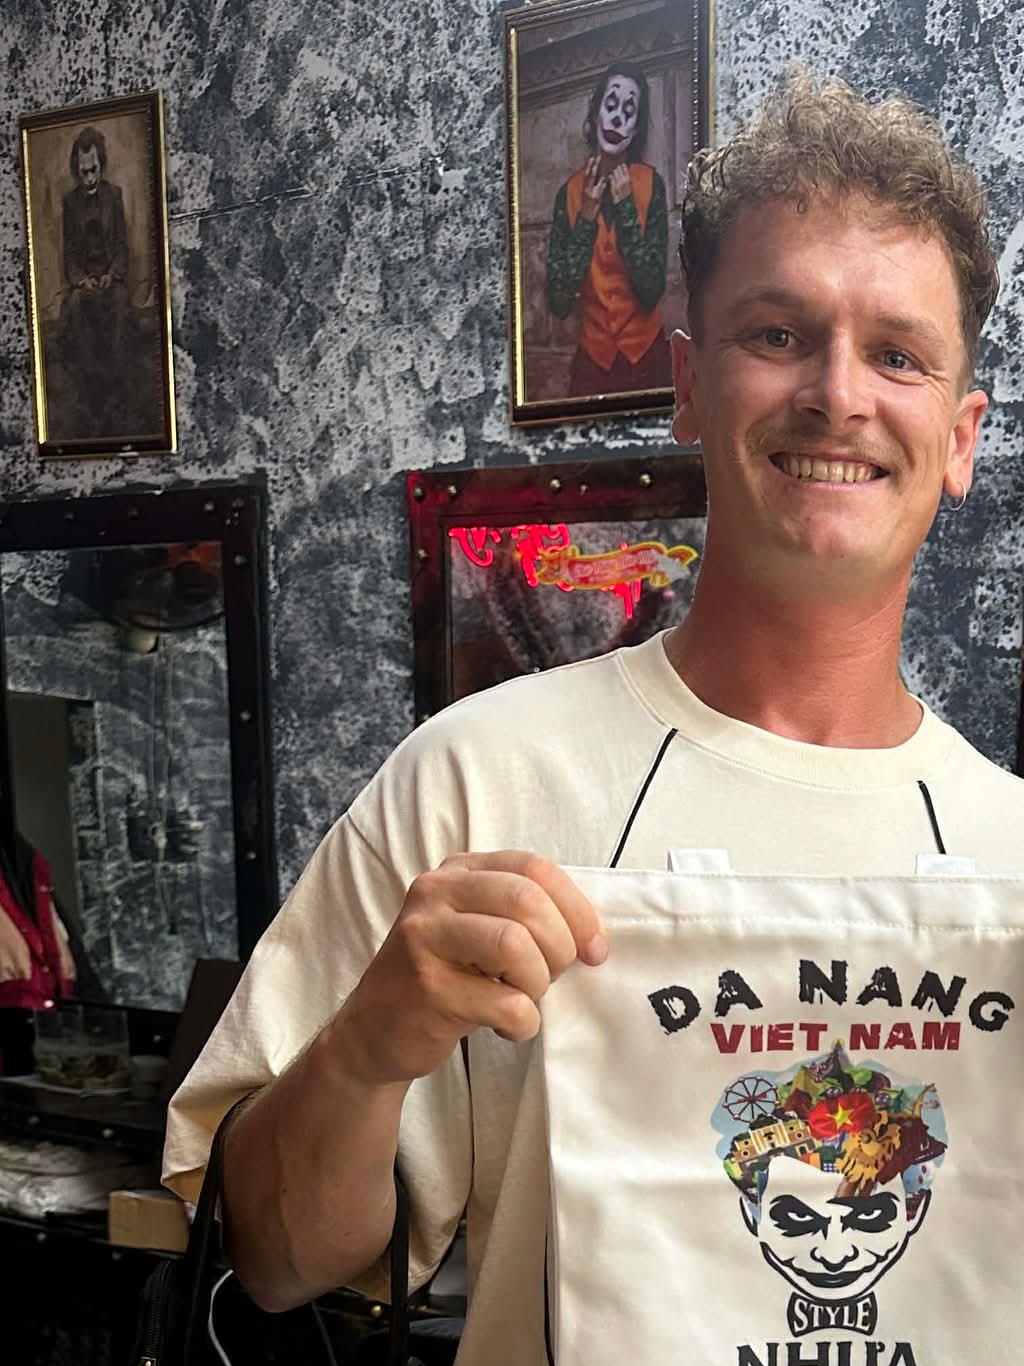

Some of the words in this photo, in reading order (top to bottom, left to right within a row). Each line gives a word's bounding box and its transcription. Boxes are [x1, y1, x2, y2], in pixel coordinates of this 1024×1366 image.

[648, 969, 763, 1036] DA
[798, 960, 1015, 1032] NANG
[710, 1022, 828, 1054] VIET
[850, 1022, 961, 1051] NAM
[793, 1298, 873, 1333] STYLE
